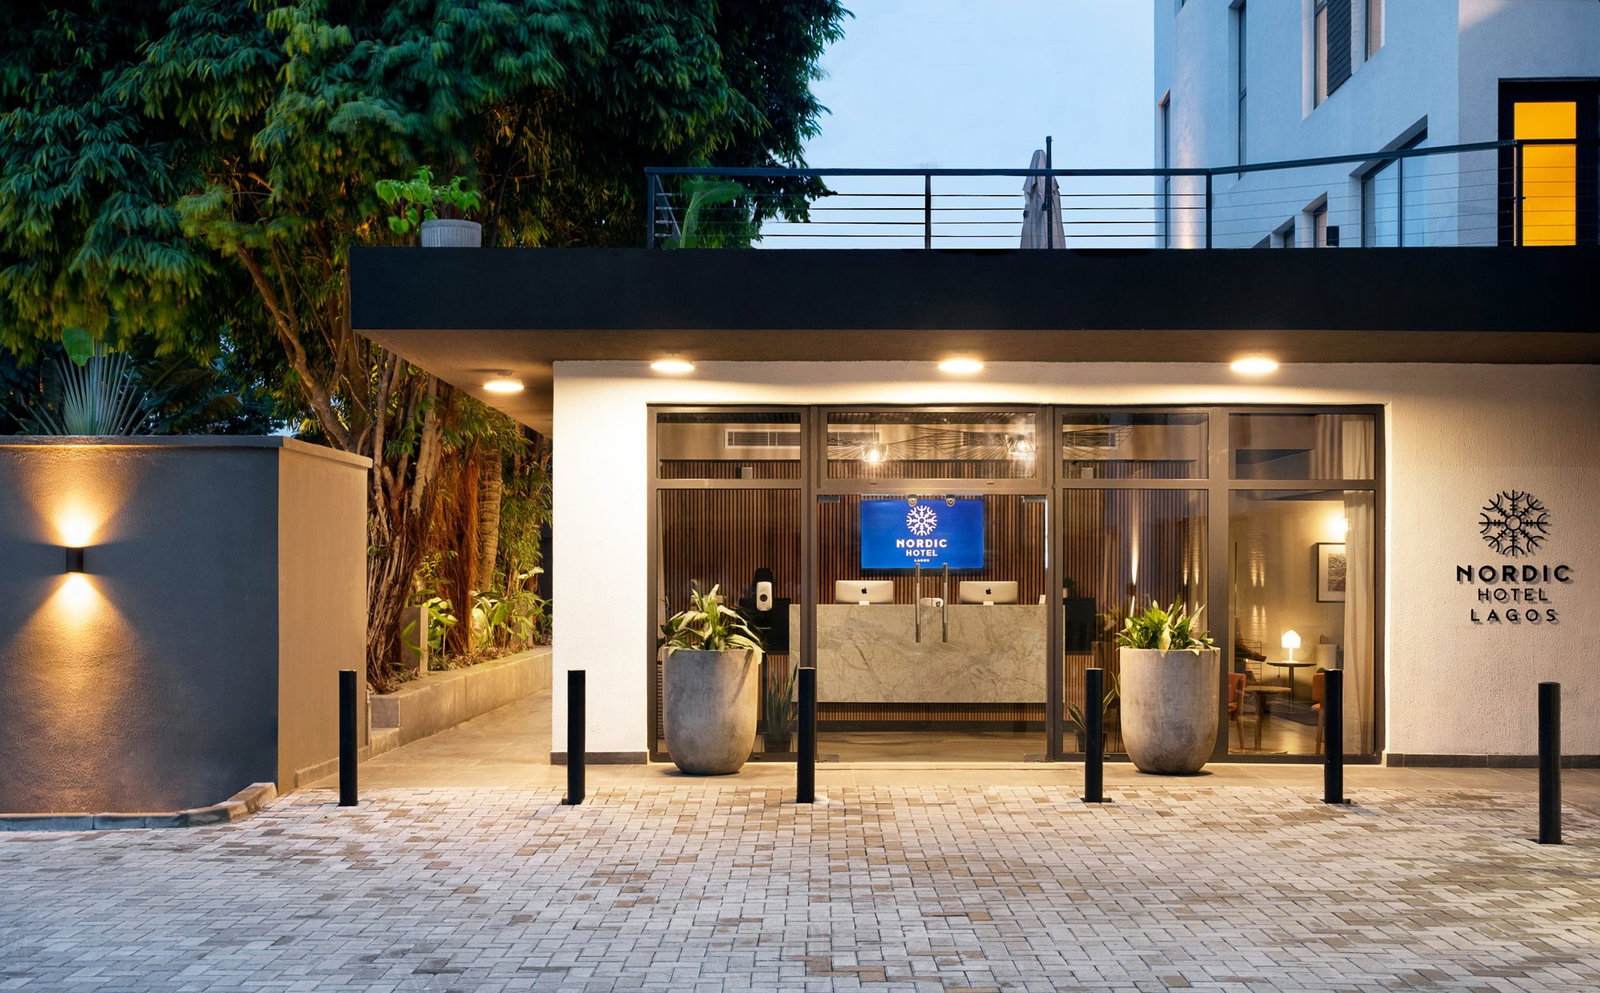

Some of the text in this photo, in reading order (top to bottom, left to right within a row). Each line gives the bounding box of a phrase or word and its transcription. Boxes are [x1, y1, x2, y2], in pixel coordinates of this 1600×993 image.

[896, 539, 947, 548] NORDIC
[905, 549, 938, 557] HOTEL
[1456, 565, 1570, 582] NORDIC
[1478, 588, 1548, 601] HOTEL
[1470, 608, 1556, 622] LAGOS
